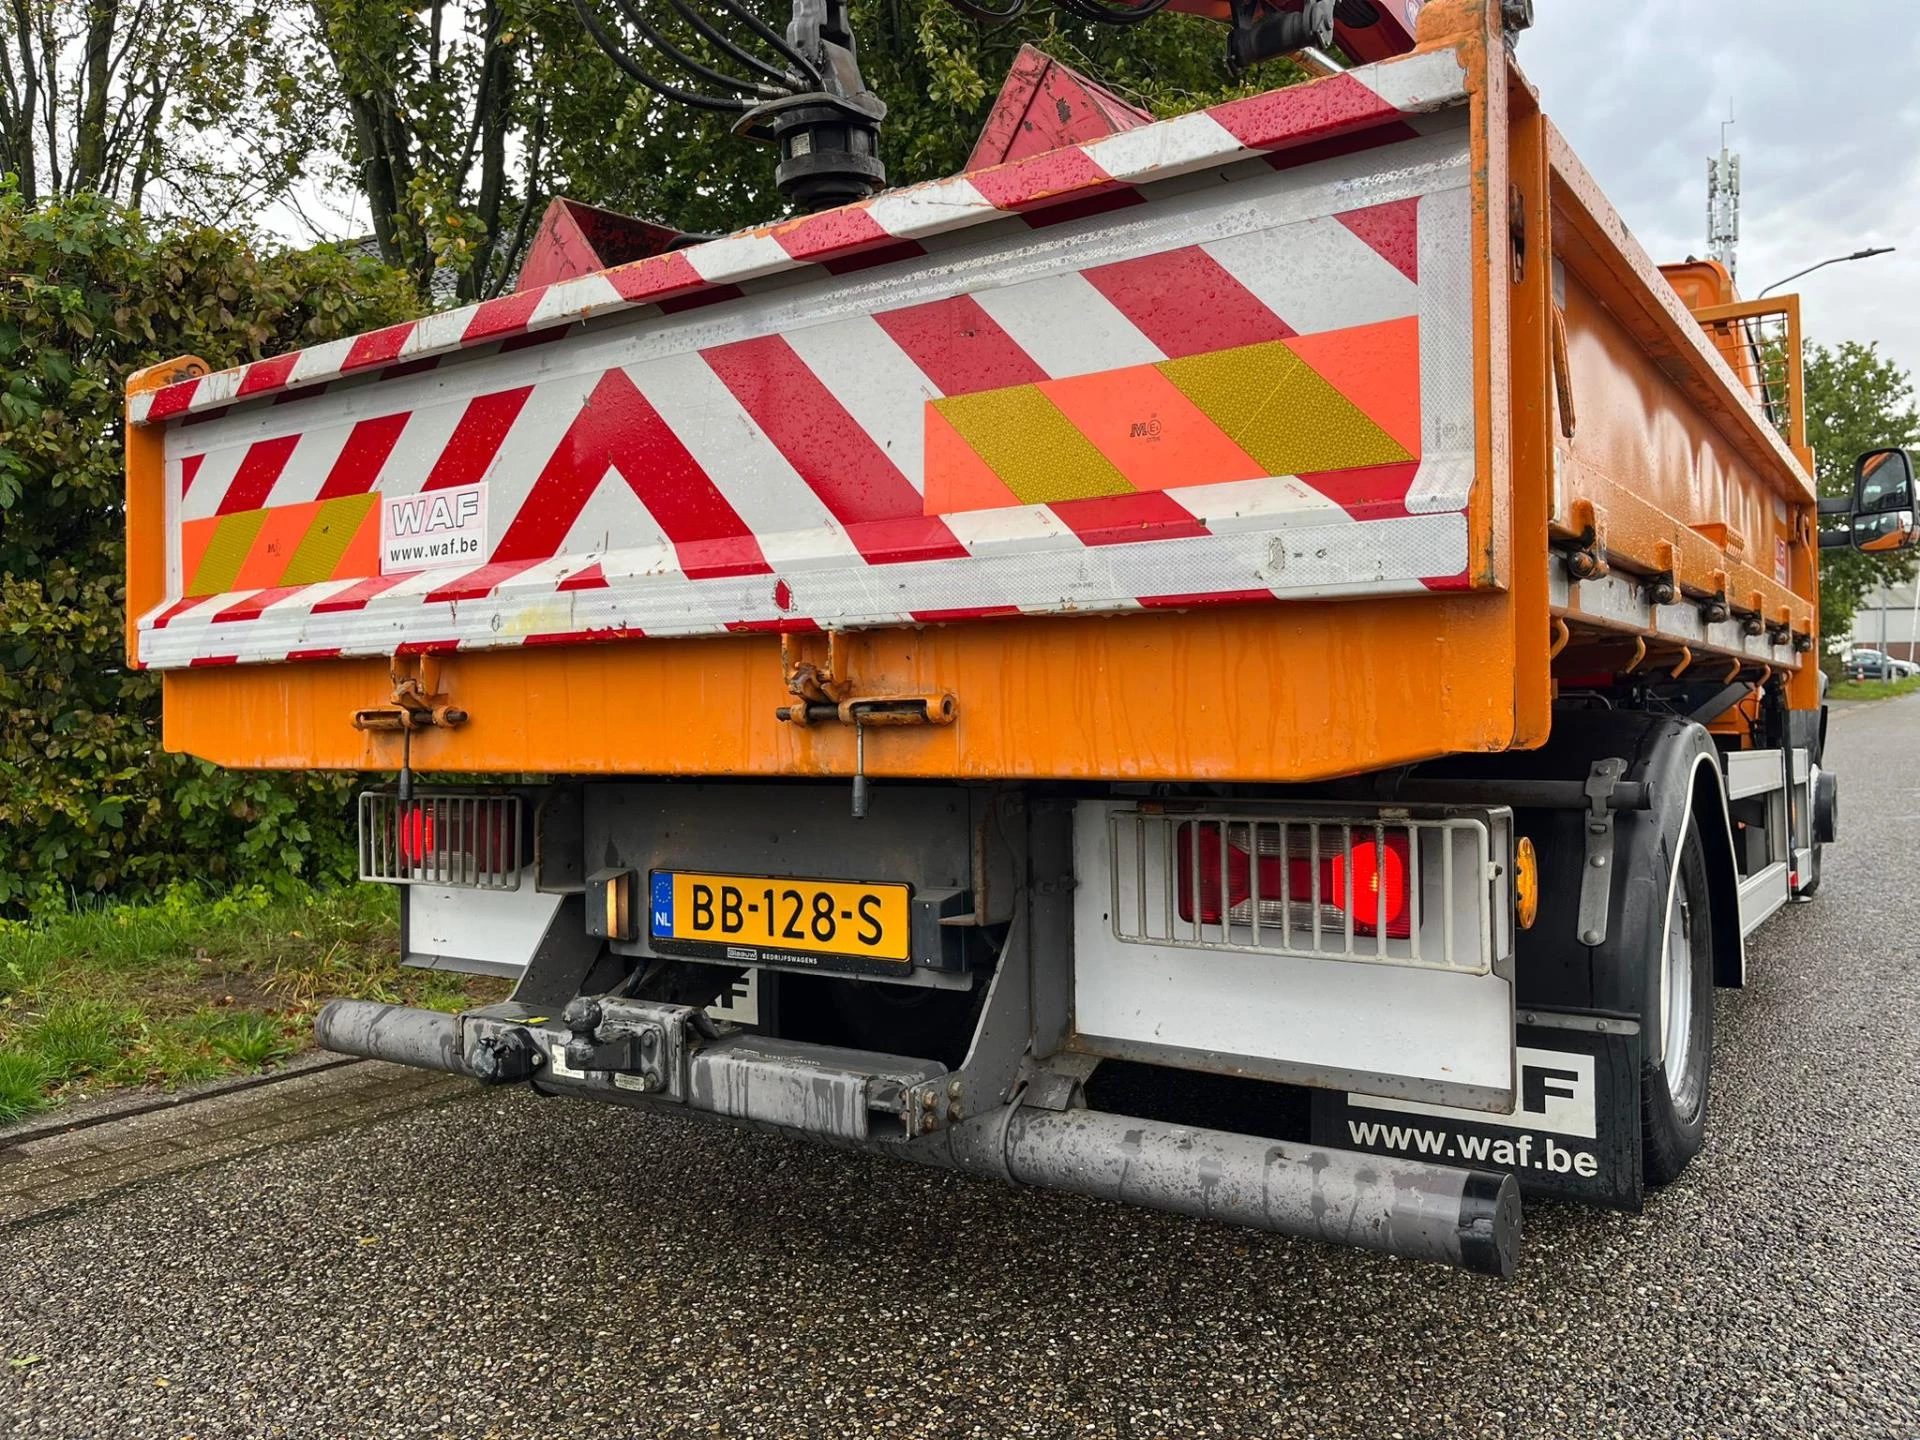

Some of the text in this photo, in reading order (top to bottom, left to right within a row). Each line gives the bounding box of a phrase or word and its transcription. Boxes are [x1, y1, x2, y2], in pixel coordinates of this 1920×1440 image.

[392, 491, 479, 536] WAF
[390, 537, 478, 562] www.waf.be
[655, 884, 883, 946] NL BB-128-S
[761, 952, 818, 965] BEDRIJFSWAGENS
[1347, 1119, 1598, 1178] www.waf.be
